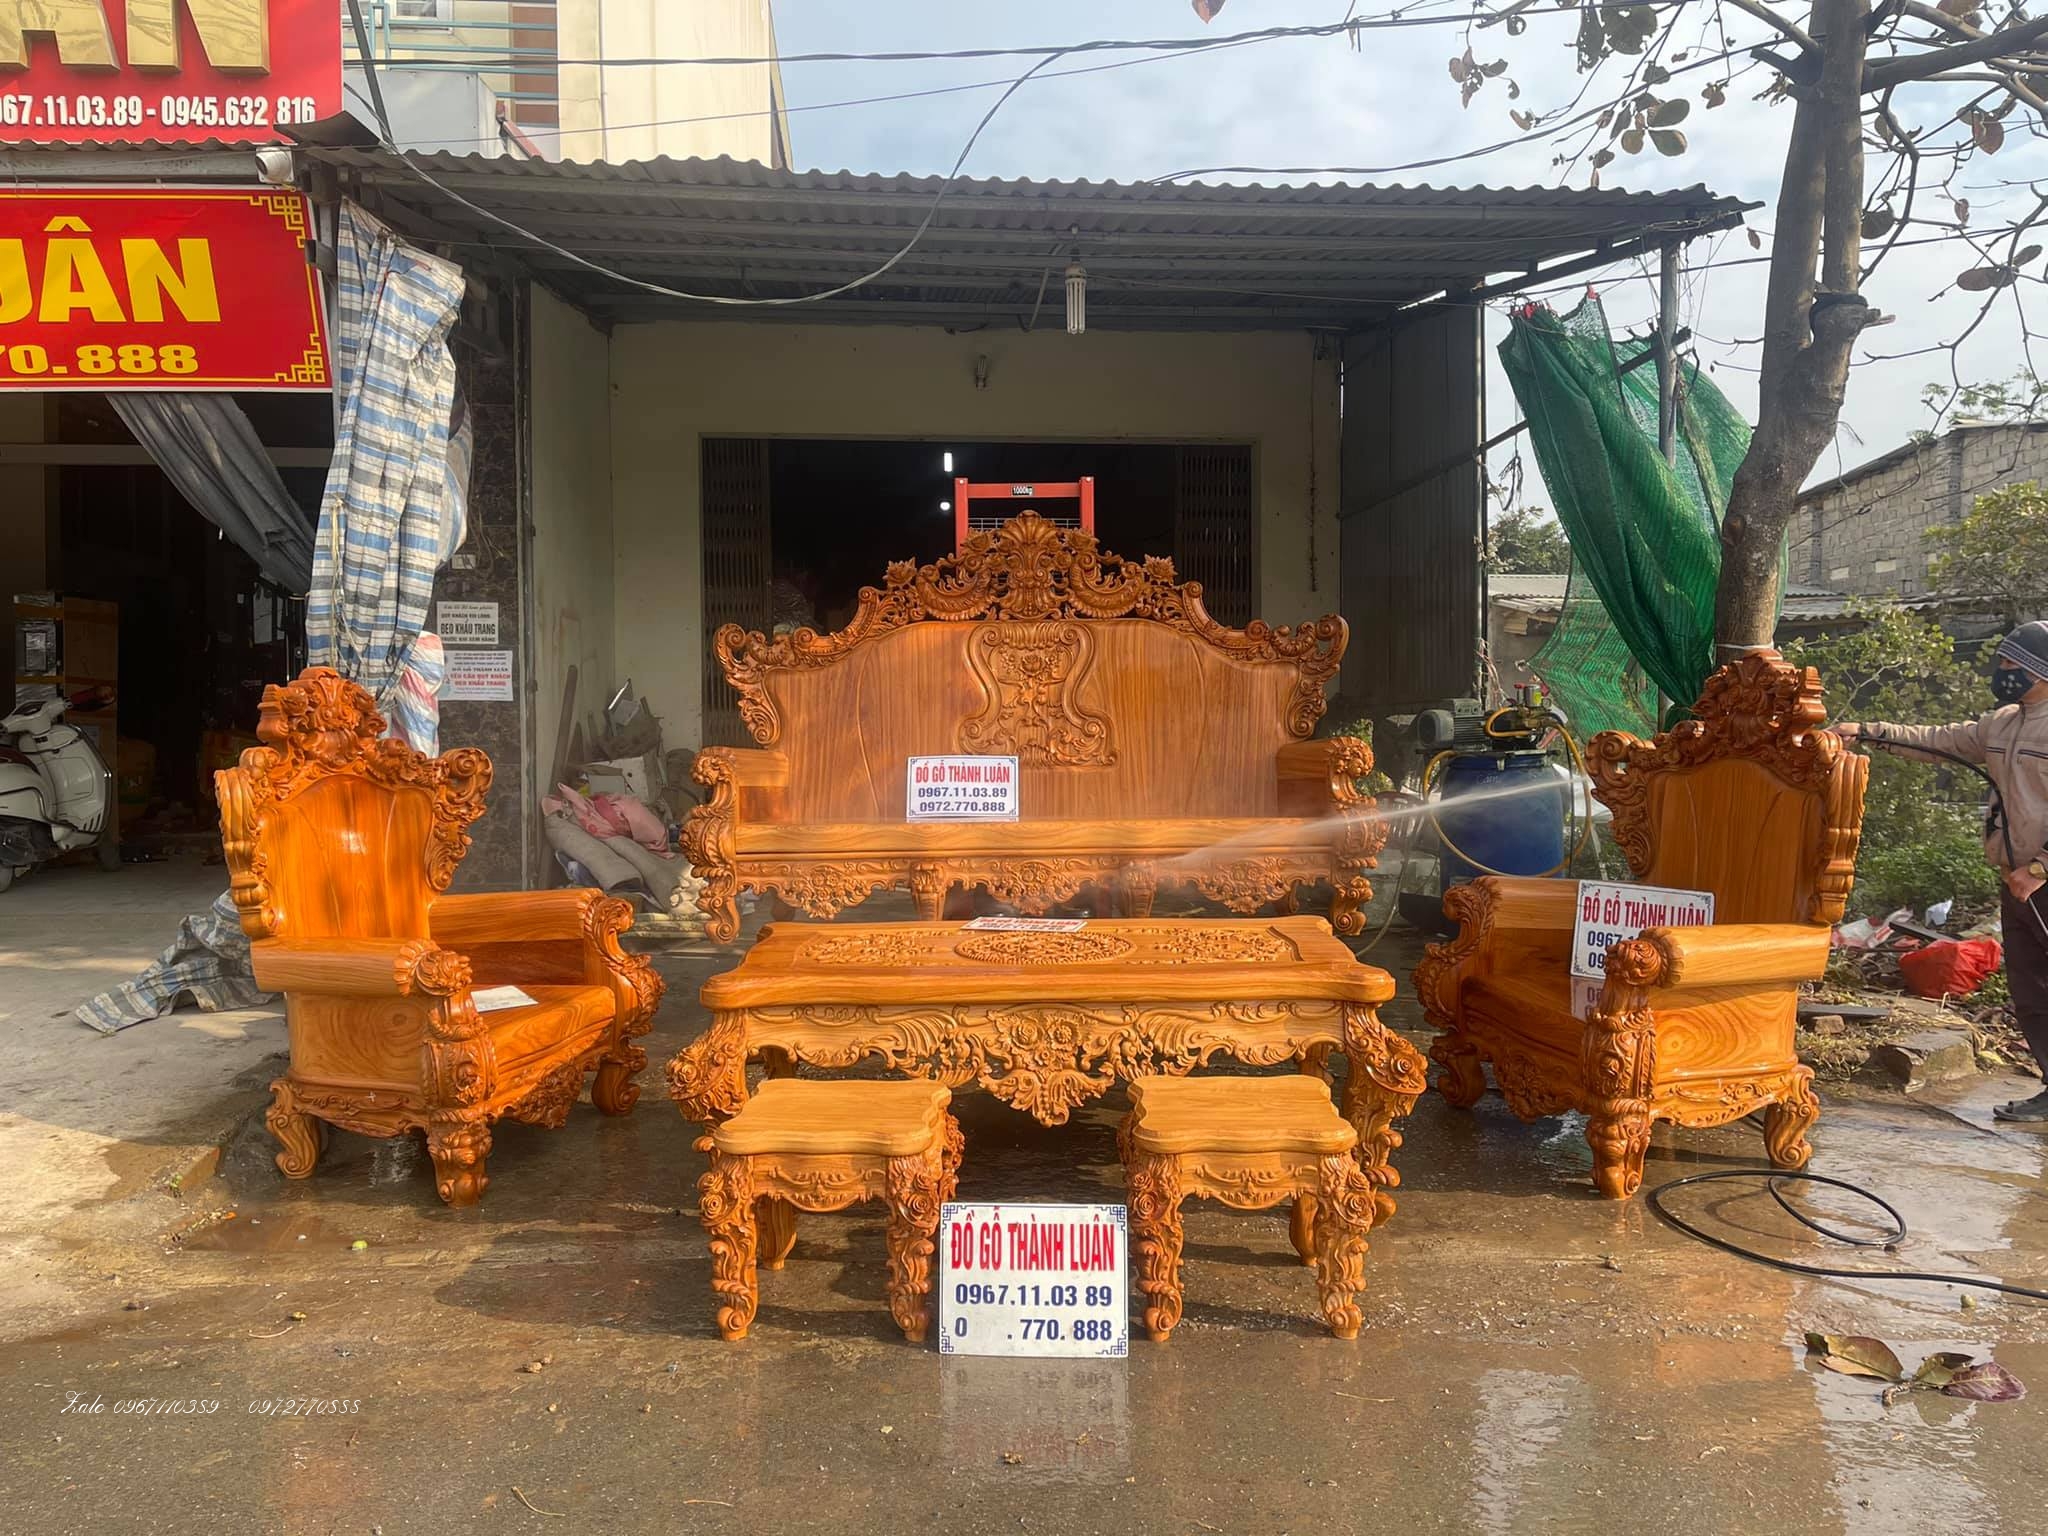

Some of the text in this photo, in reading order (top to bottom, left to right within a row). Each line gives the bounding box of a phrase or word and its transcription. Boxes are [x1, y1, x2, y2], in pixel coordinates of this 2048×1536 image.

[0, 94, 143, 126] 67.11.03.89
[0, 344, 199, 375] 0.888
[474, 623, 496, 635] TRANG
[948, 762, 981, 783] THÀNH
[984, 763, 1010, 783] LUÂN
[918, 787, 1007, 798] 0967.11.03.89
[920, 801, 1005, 812] 0972.770.888
[1583, 889, 1601, 924] ĐỒ
[1604, 890, 1621, 926] GỖ
[1625, 897, 1667, 928] THÀNH
[951, 1206, 1115, 1272] ĐỒ GỖ THÀNH LUÂN
